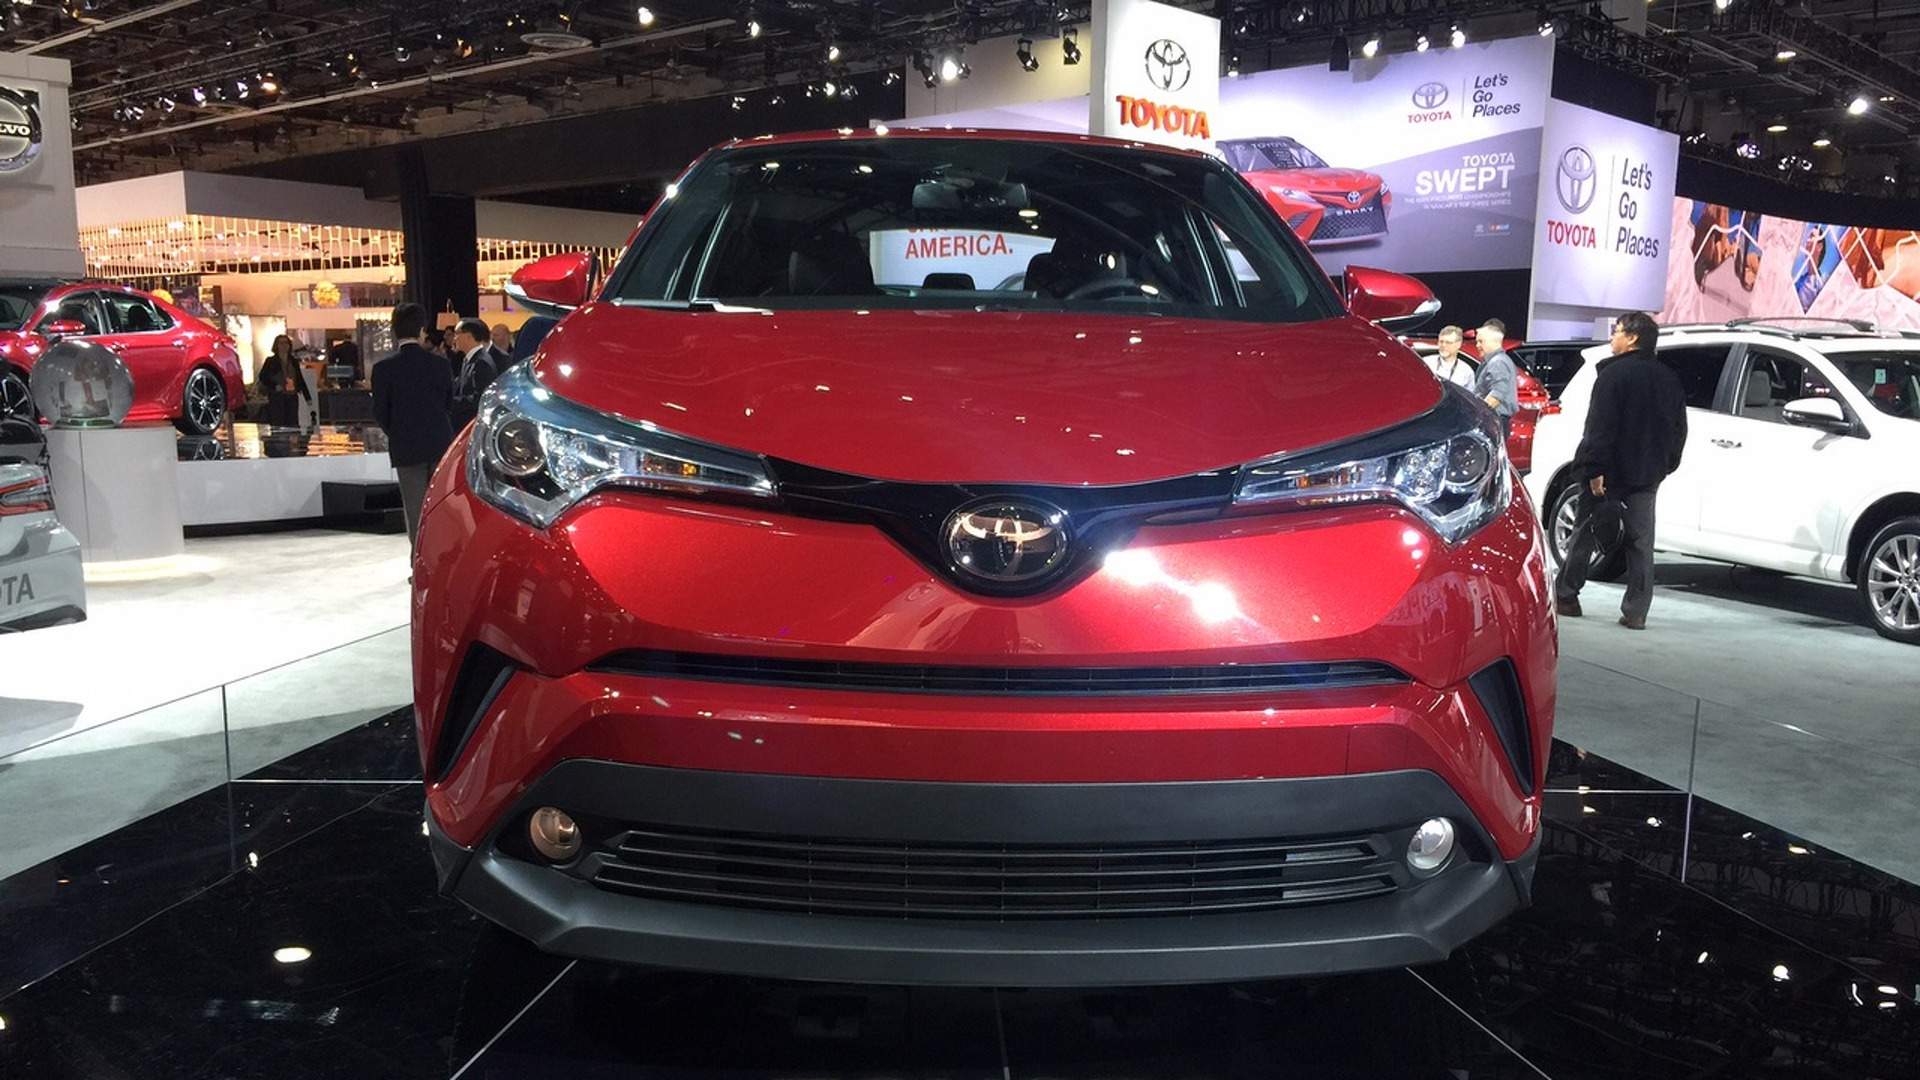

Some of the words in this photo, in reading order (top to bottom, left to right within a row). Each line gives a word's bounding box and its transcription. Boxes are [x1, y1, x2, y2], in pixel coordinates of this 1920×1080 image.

[1474, 73, 1508, 89] Let's
[1472, 103, 1522, 118] Places
[1473, 90, 1494, 103] Go
[1116, 95, 1210, 140] TOYOTA
[1407, 111, 1452, 124] TOYOTA
[1462, 152, 1515, 168] TOYOTA
[1621, 158, 1653, 190] Let's
[1415, 165, 1516, 195] SWEPT
[1618, 191, 1637, 220] Go
[905, 233, 1013, 260] AMERICA.
[1547, 220, 1597, 249] TOYOTA
[1615, 226, 1660, 259] Places
[0, 573, 35, 606] TA
